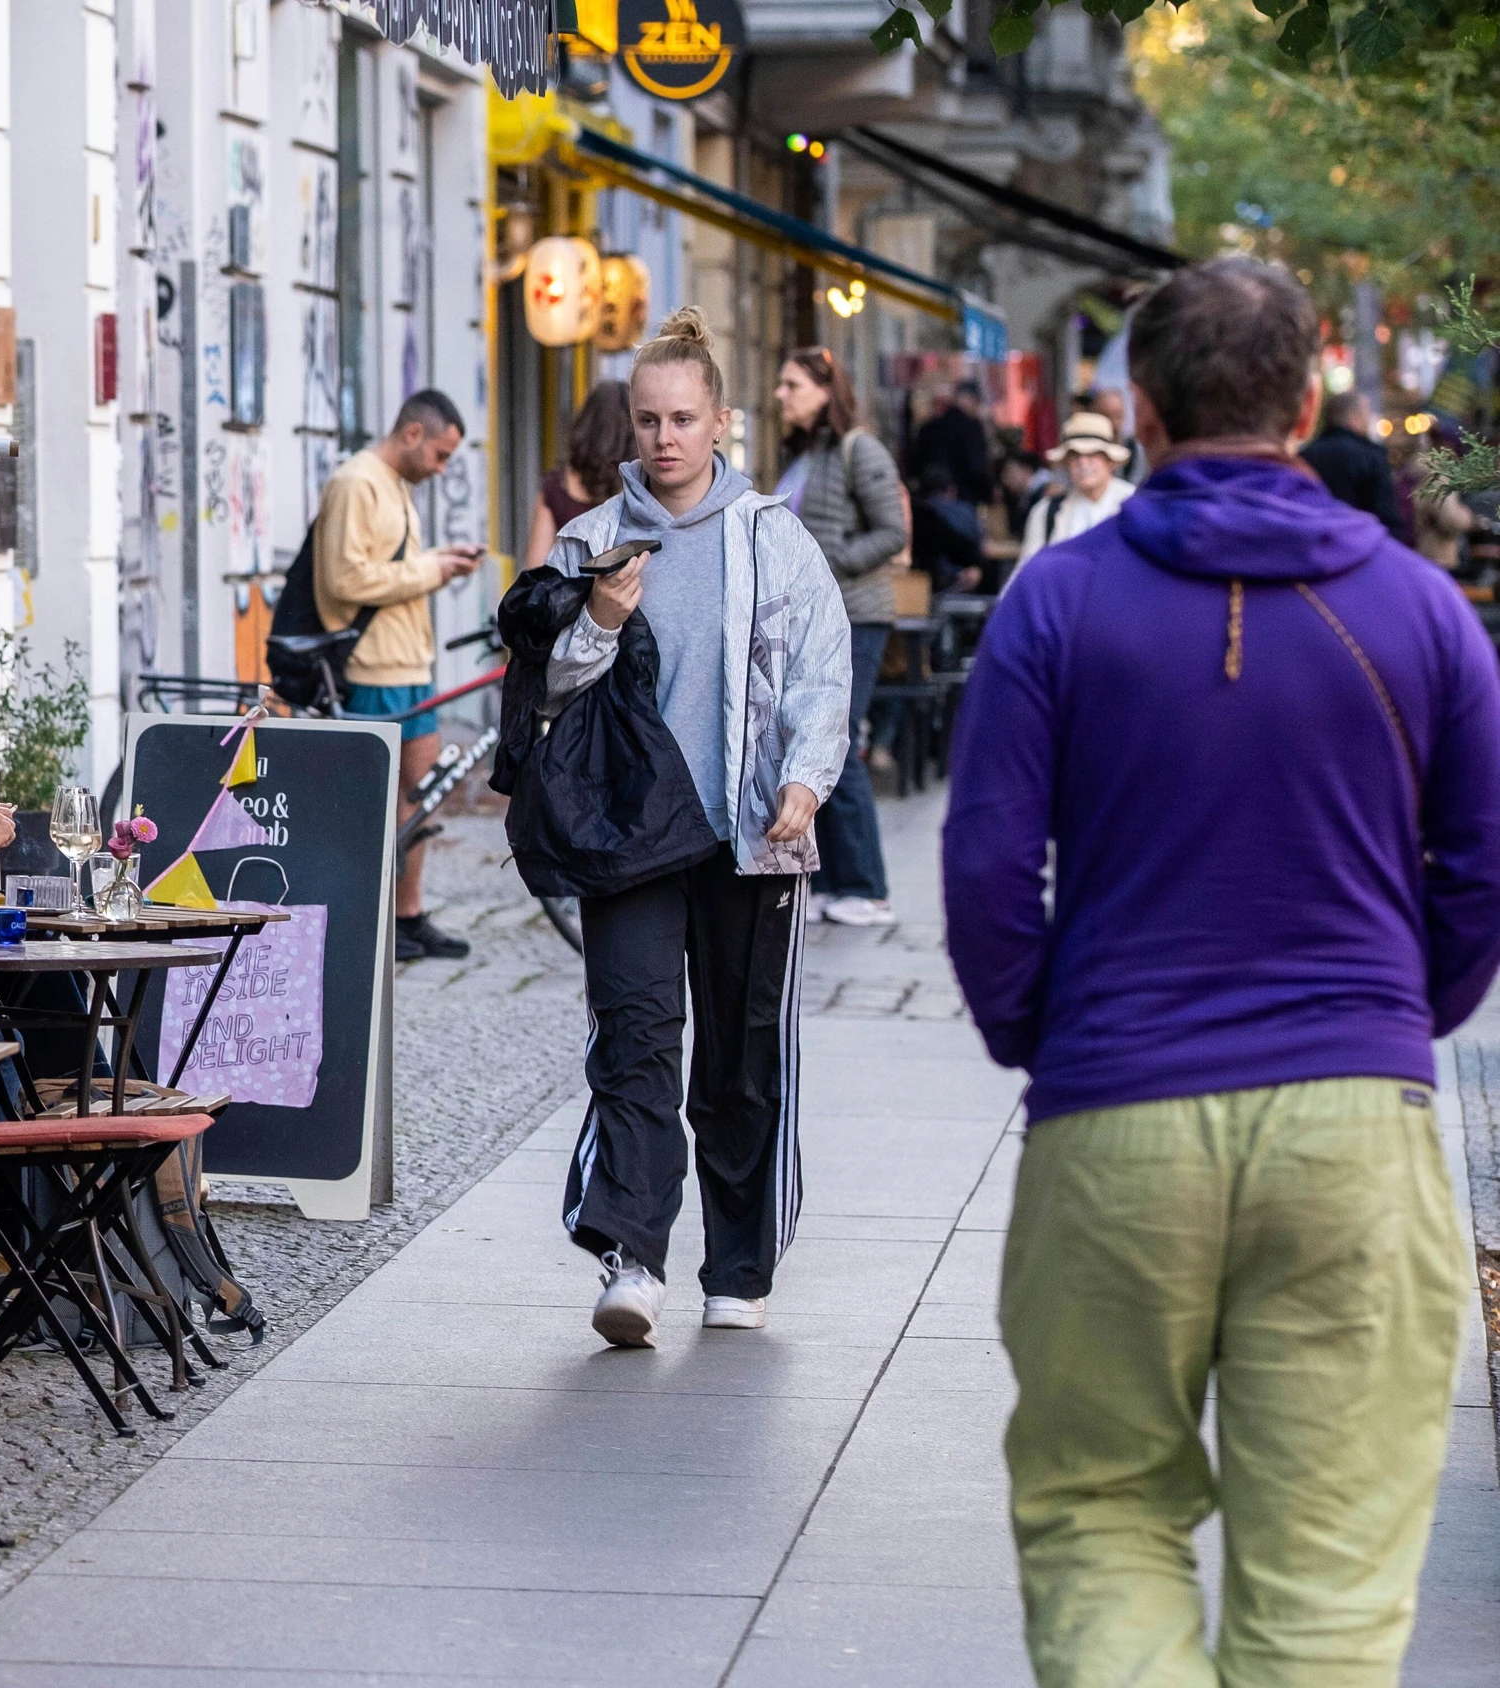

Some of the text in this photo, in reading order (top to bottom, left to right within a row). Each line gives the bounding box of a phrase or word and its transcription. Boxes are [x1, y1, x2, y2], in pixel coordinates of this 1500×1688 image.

[638, 21, 722, 53] ZEN
[230, 791, 289, 819] eo &
